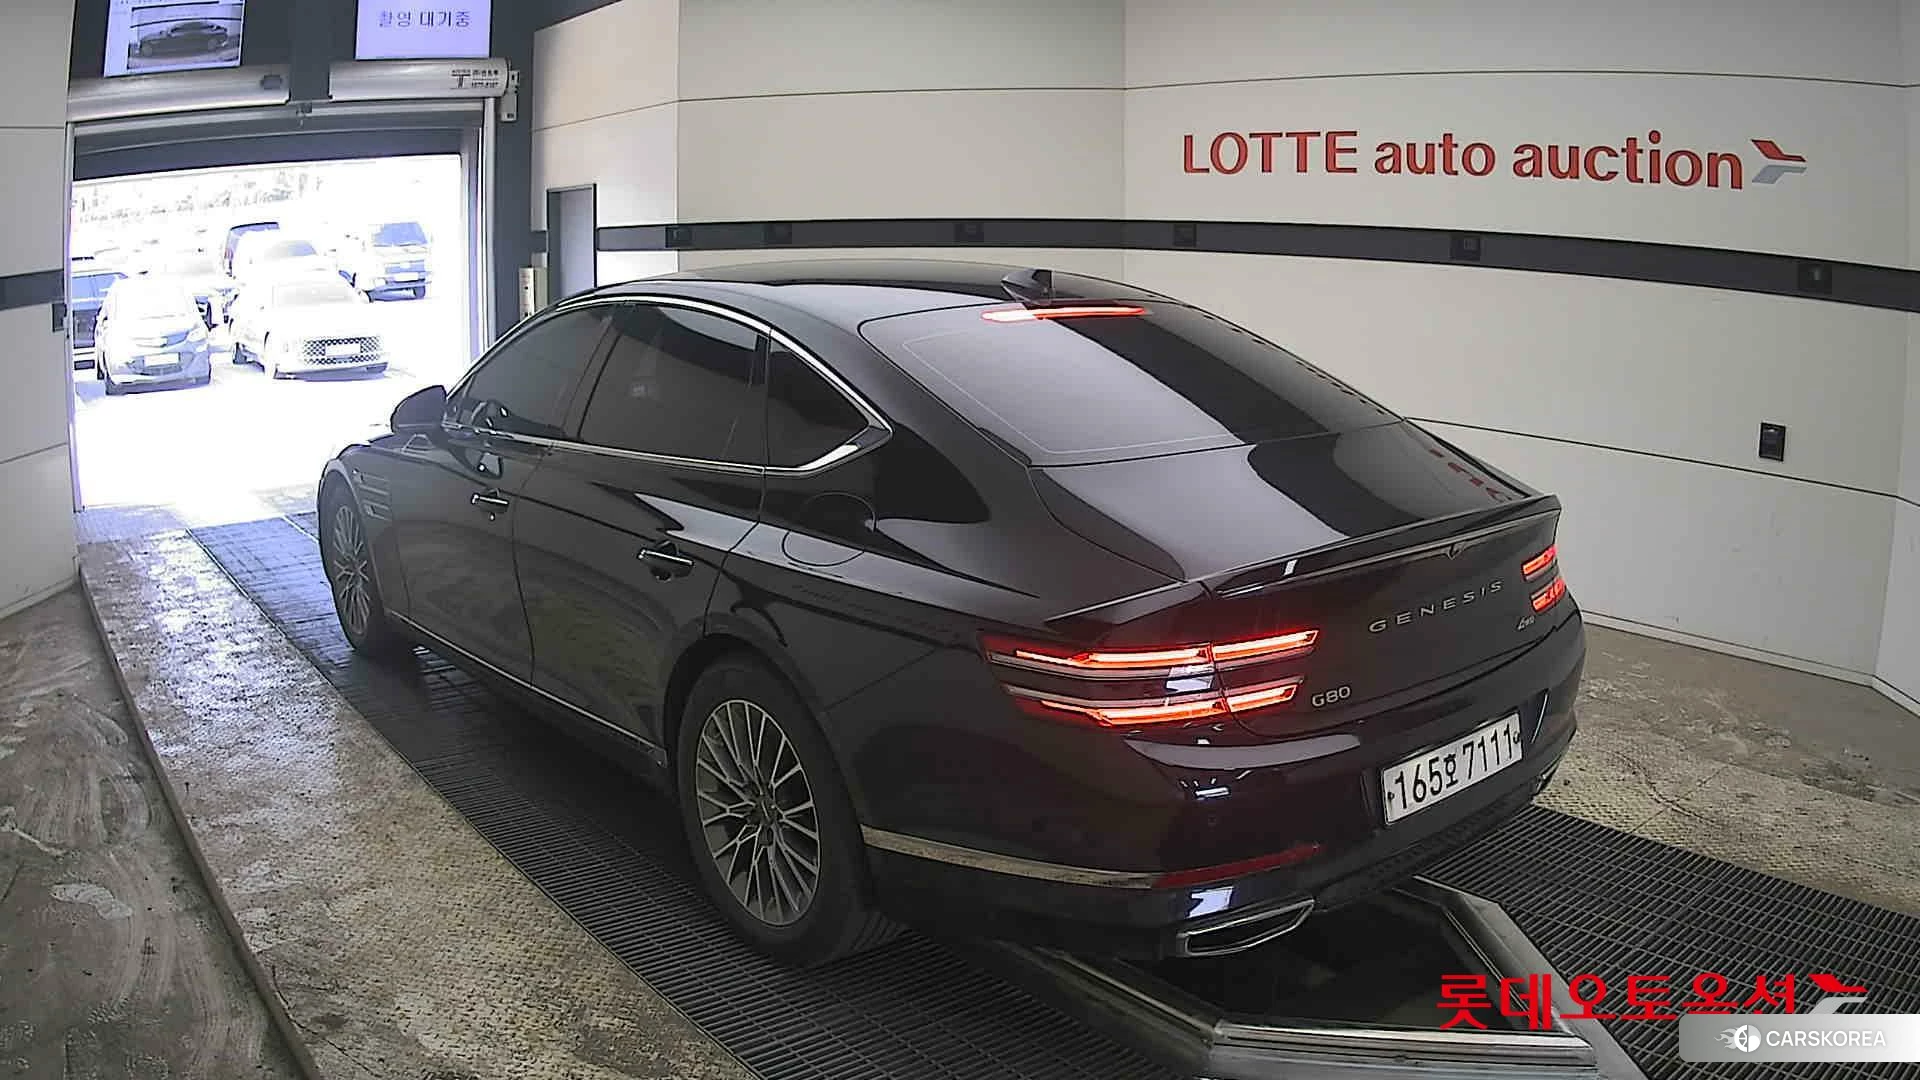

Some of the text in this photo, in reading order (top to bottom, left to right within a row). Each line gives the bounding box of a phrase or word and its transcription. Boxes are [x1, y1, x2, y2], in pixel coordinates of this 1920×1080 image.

[420, 11, 470, 27] 대기중
[1183, 130, 1744, 190] LOTTE auto auction
[1368, 580, 1502, 634] GENESIS
[1311, 686, 1352, 708] G80
[1462, 723, 1513, 780] 7111
